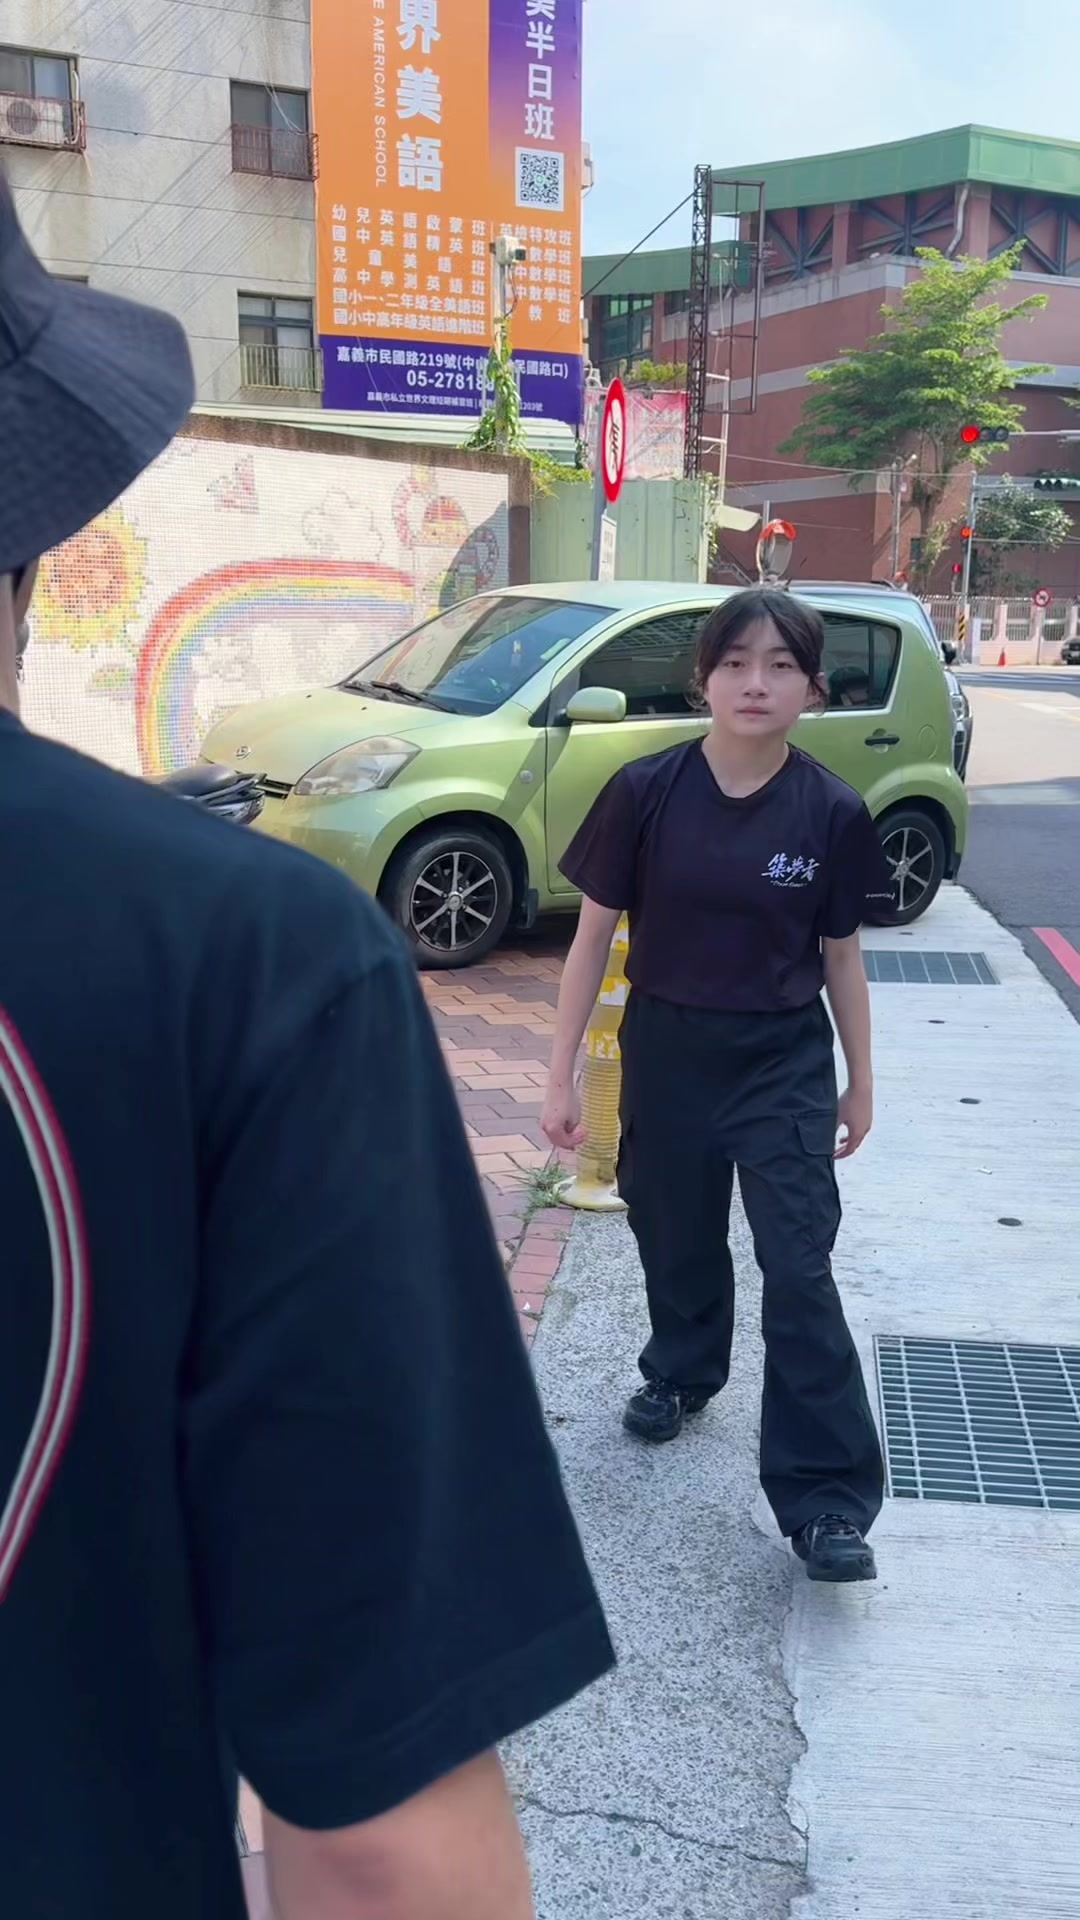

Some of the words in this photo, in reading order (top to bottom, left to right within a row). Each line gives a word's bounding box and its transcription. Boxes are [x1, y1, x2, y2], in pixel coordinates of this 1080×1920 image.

[372, 16, 386, 109] AMERICAN
[396, 0, 443, 192] 界美語
[374, 115, 388, 188] SCHOOL
[505, 264, 572, 286] 中數學班
